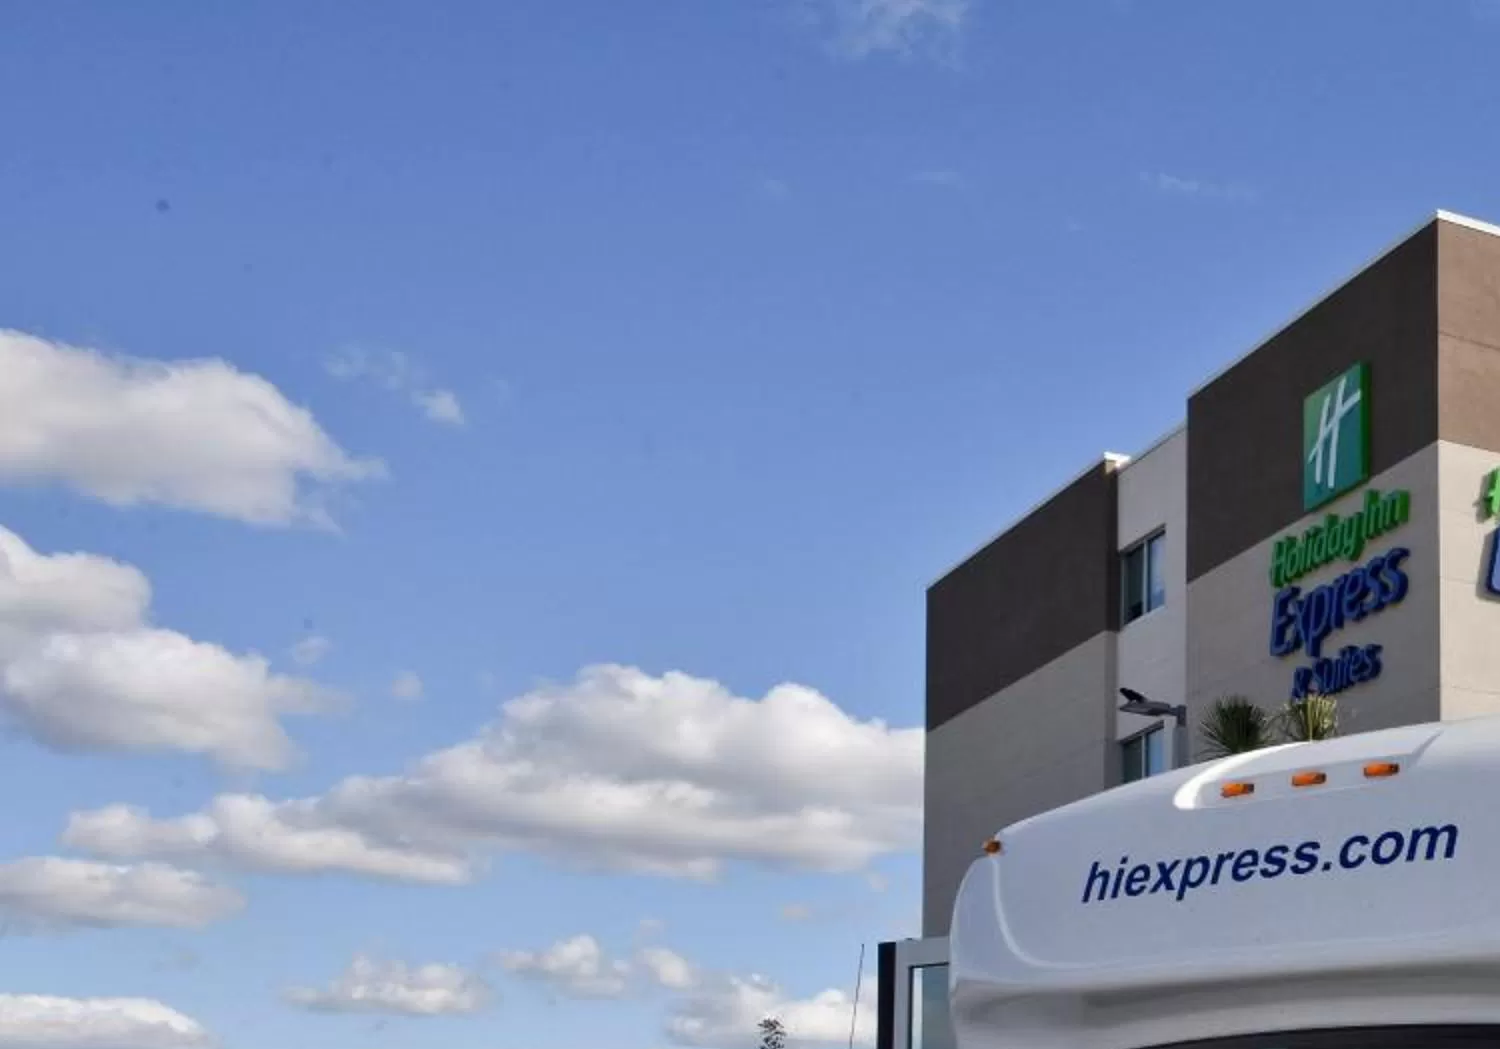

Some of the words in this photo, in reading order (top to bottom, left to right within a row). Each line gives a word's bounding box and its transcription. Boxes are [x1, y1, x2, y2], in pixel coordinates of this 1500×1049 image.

[1270, 512, 1364, 588] Holiday
[1363, 488, 1411, 540] Inn
[1270, 547, 1411, 657] Express
[1313, 643, 1384, 696] Suites
[1081, 822, 1459, 902] hiexpress.com
